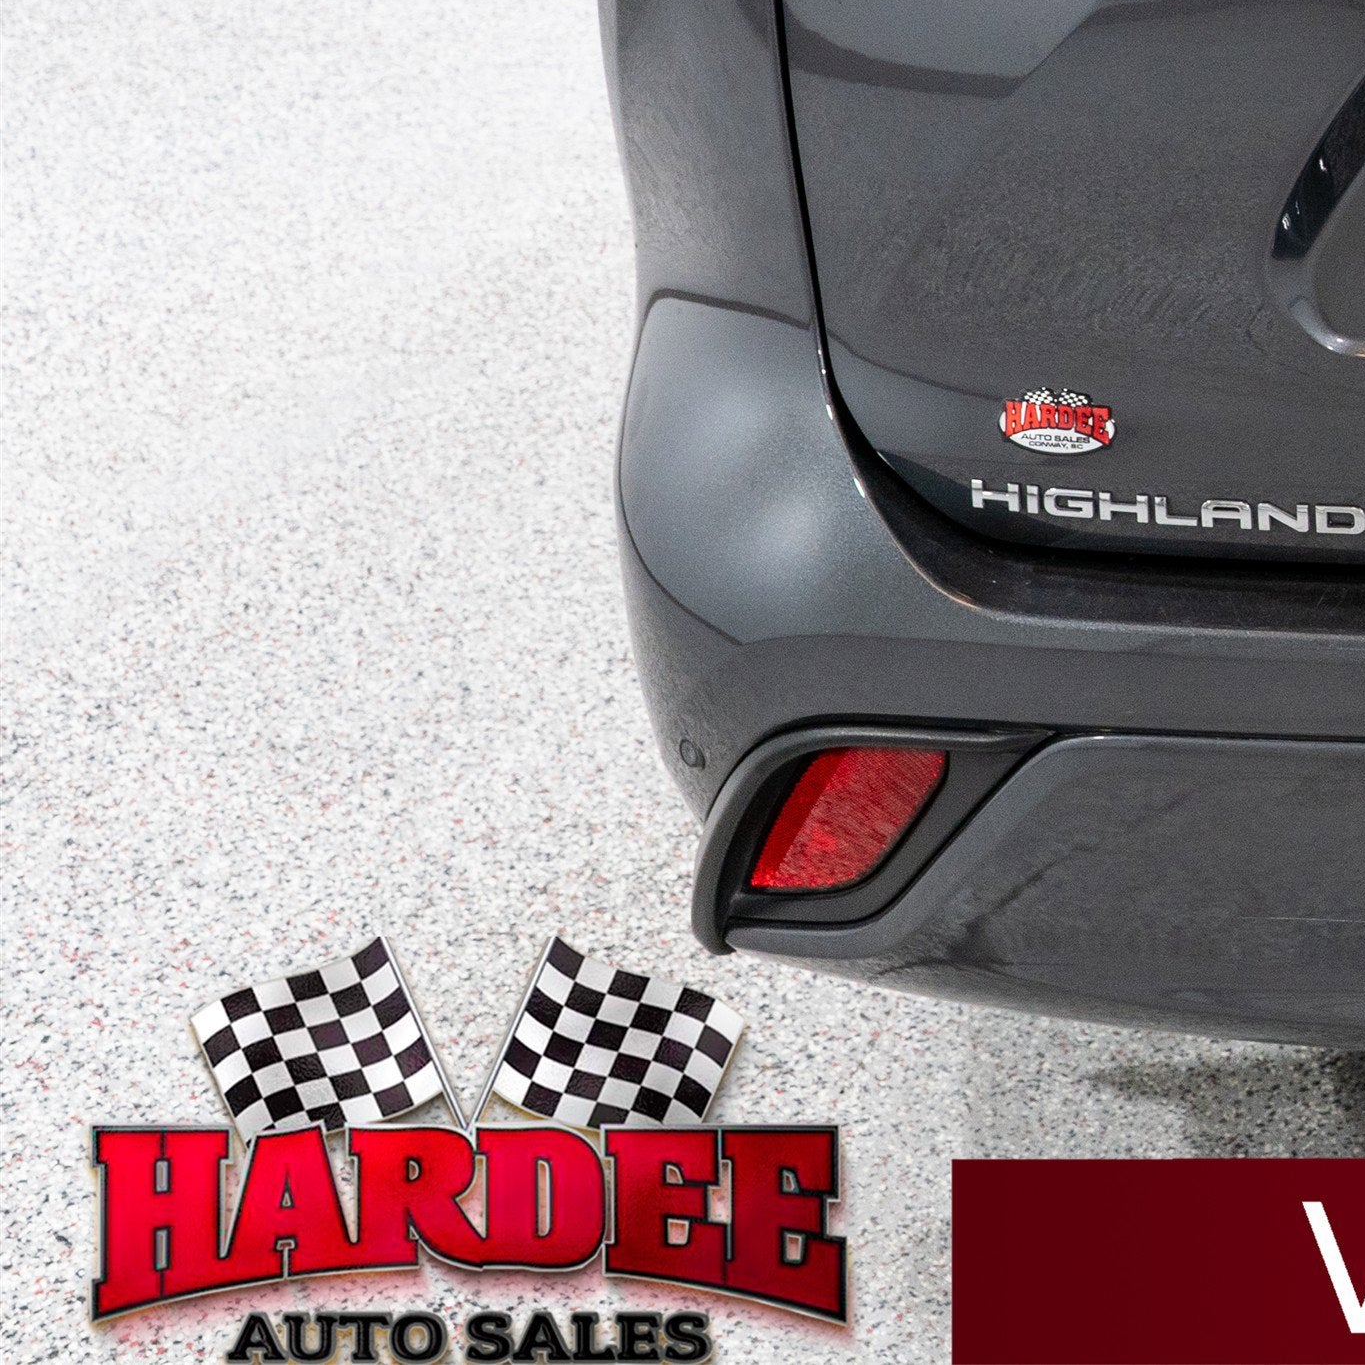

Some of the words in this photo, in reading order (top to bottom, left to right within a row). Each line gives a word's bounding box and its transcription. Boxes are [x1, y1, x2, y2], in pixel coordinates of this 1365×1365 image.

[1004, 399, 1111, 445] HARDEE
[1020, 433, 1052, 441] AUTO
[1054, 435, 1091, 443] SALES
[1028, 441, 1069, 449] CONWAY,
